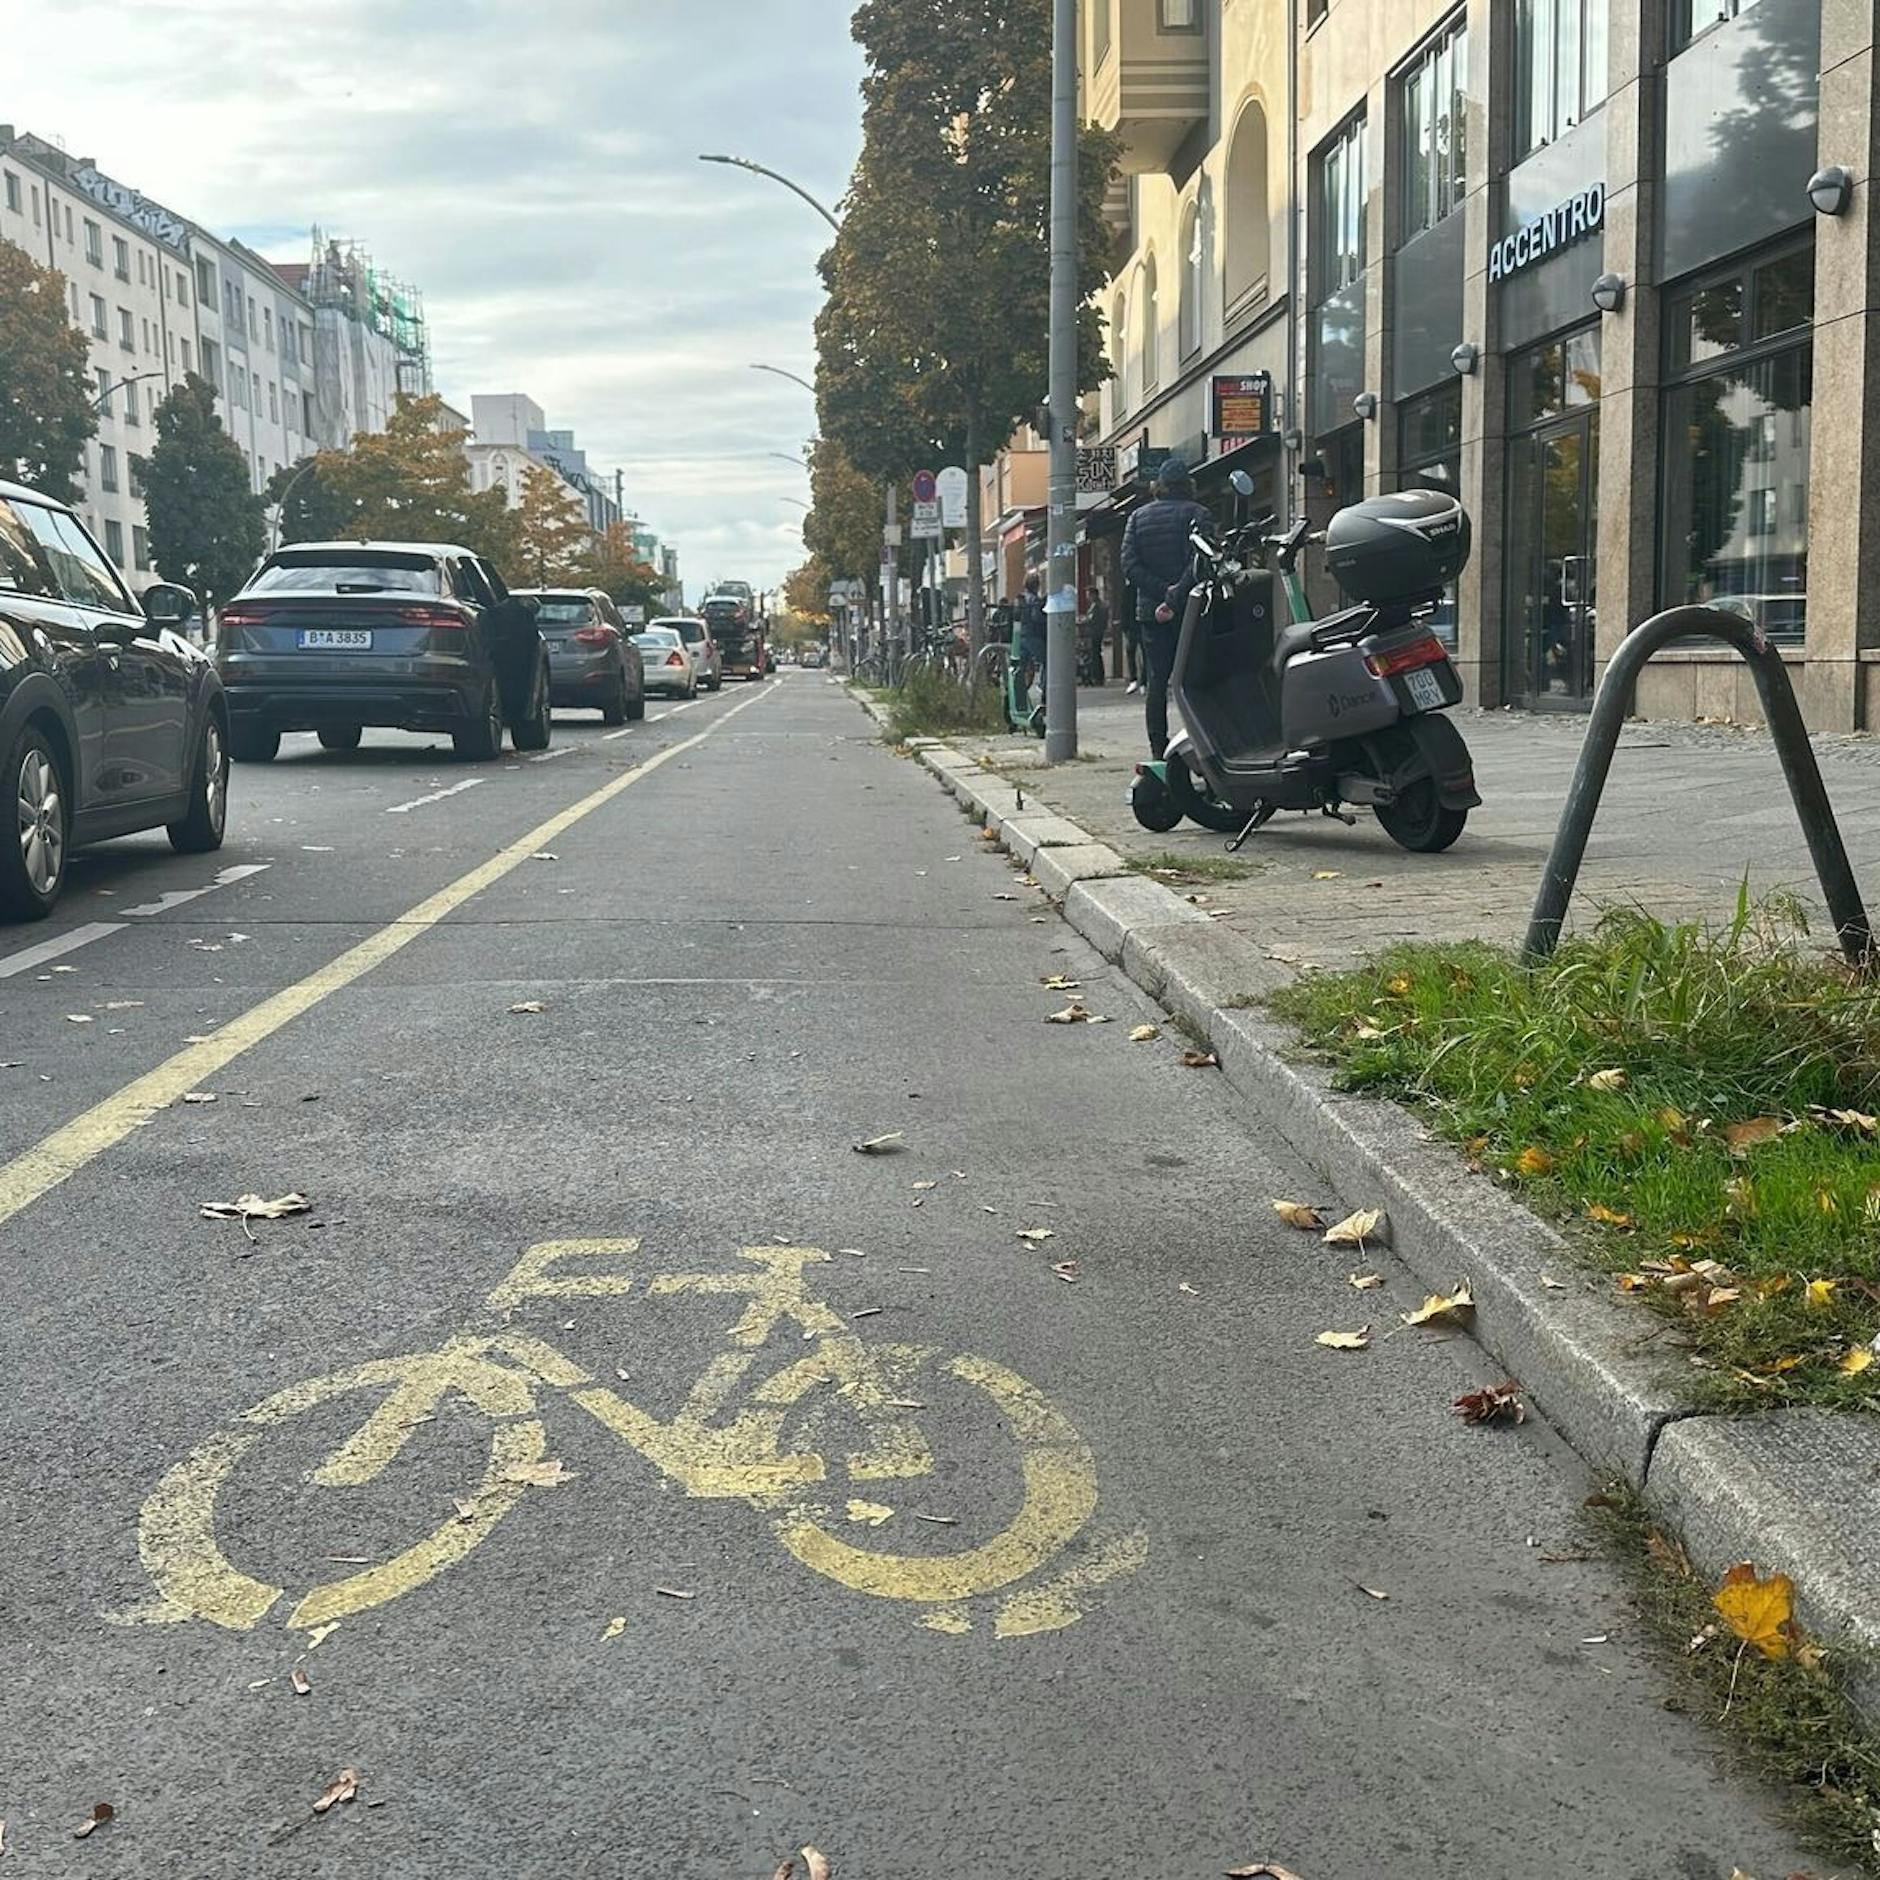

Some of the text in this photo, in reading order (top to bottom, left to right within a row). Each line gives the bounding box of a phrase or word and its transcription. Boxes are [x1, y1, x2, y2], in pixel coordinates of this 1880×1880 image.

[1488, 182, 1603, 283] ACCENTRO
[336, 632, 367, 643] 3835
[1407, 671, 1434, 690] 700
